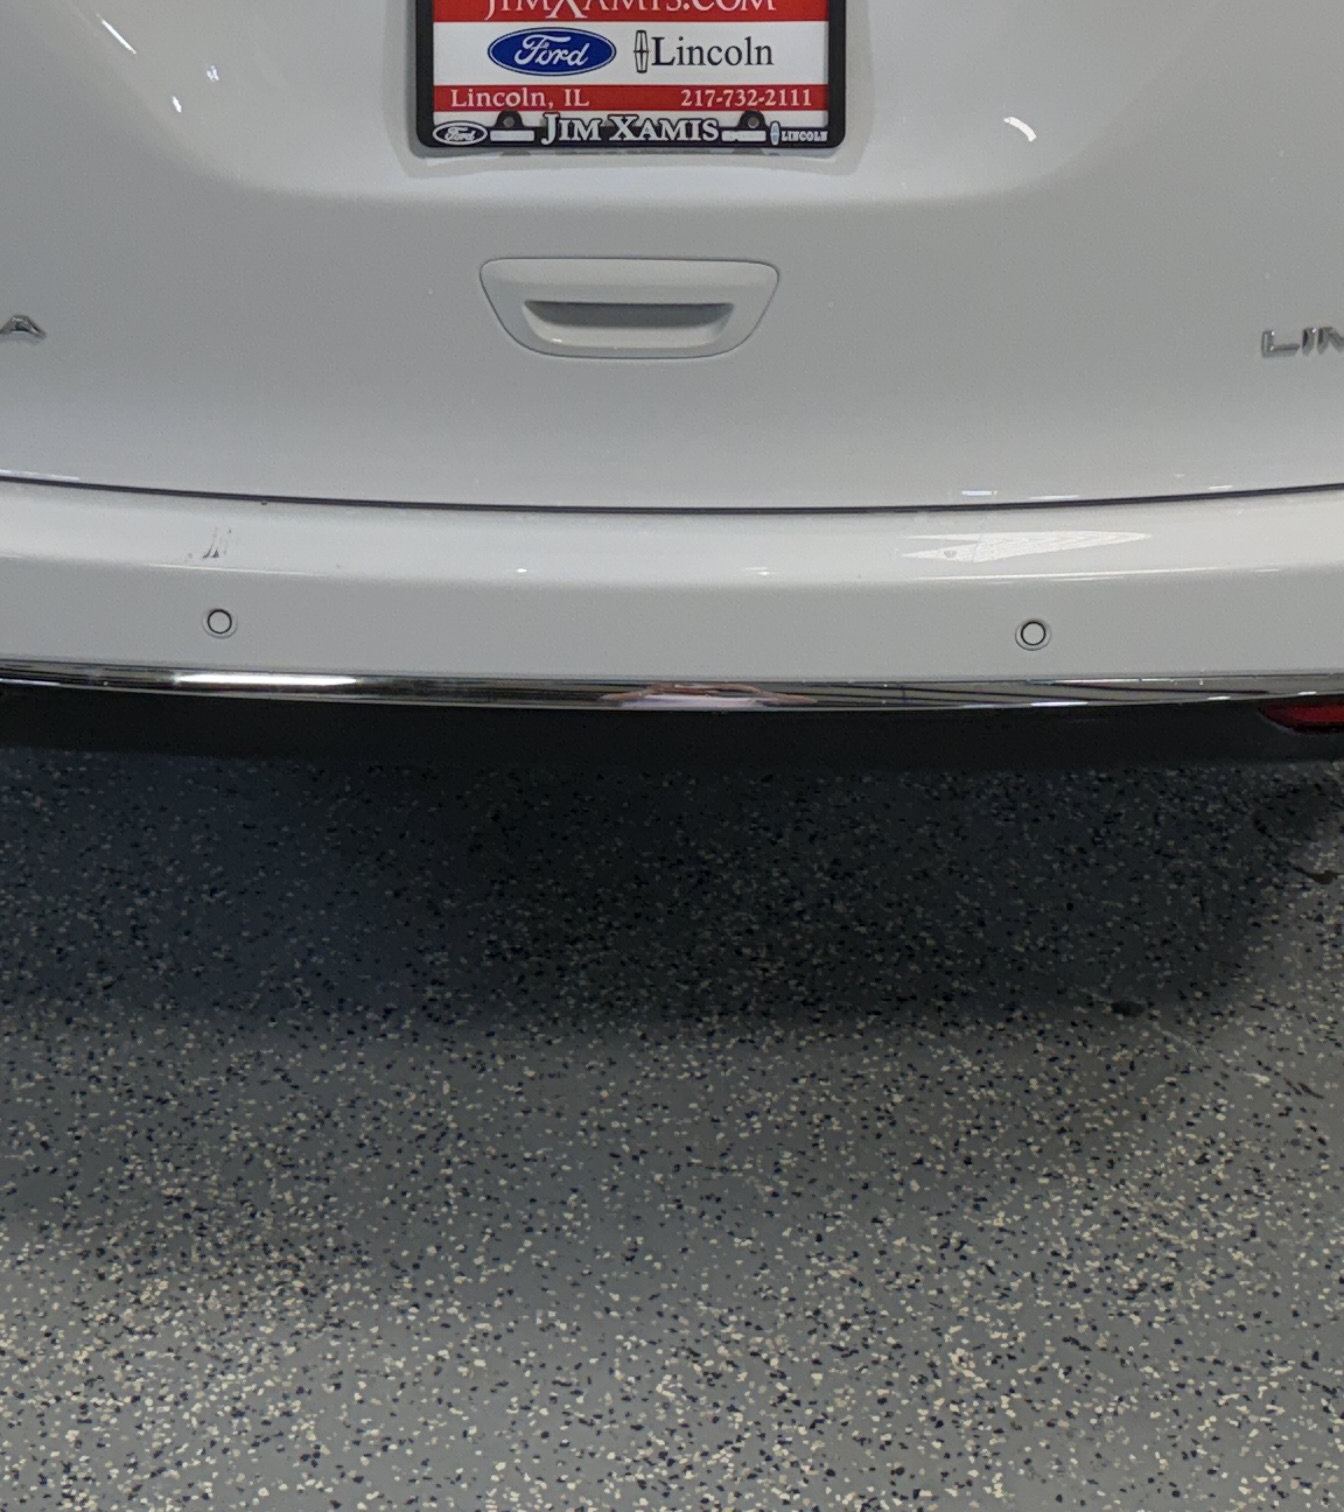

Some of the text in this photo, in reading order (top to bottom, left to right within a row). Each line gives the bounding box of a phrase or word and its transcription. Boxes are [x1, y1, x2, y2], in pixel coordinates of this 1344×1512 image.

[514, 34, 774, 67] Ford Lincoln
[450, 88, 812, 109] Lincoln, IL 217-732-2111
[540, 113, 602, 145] JIM
[608, 115, 719, 142] XAMIS
[781, 131, 828, 142] LINCOLN
